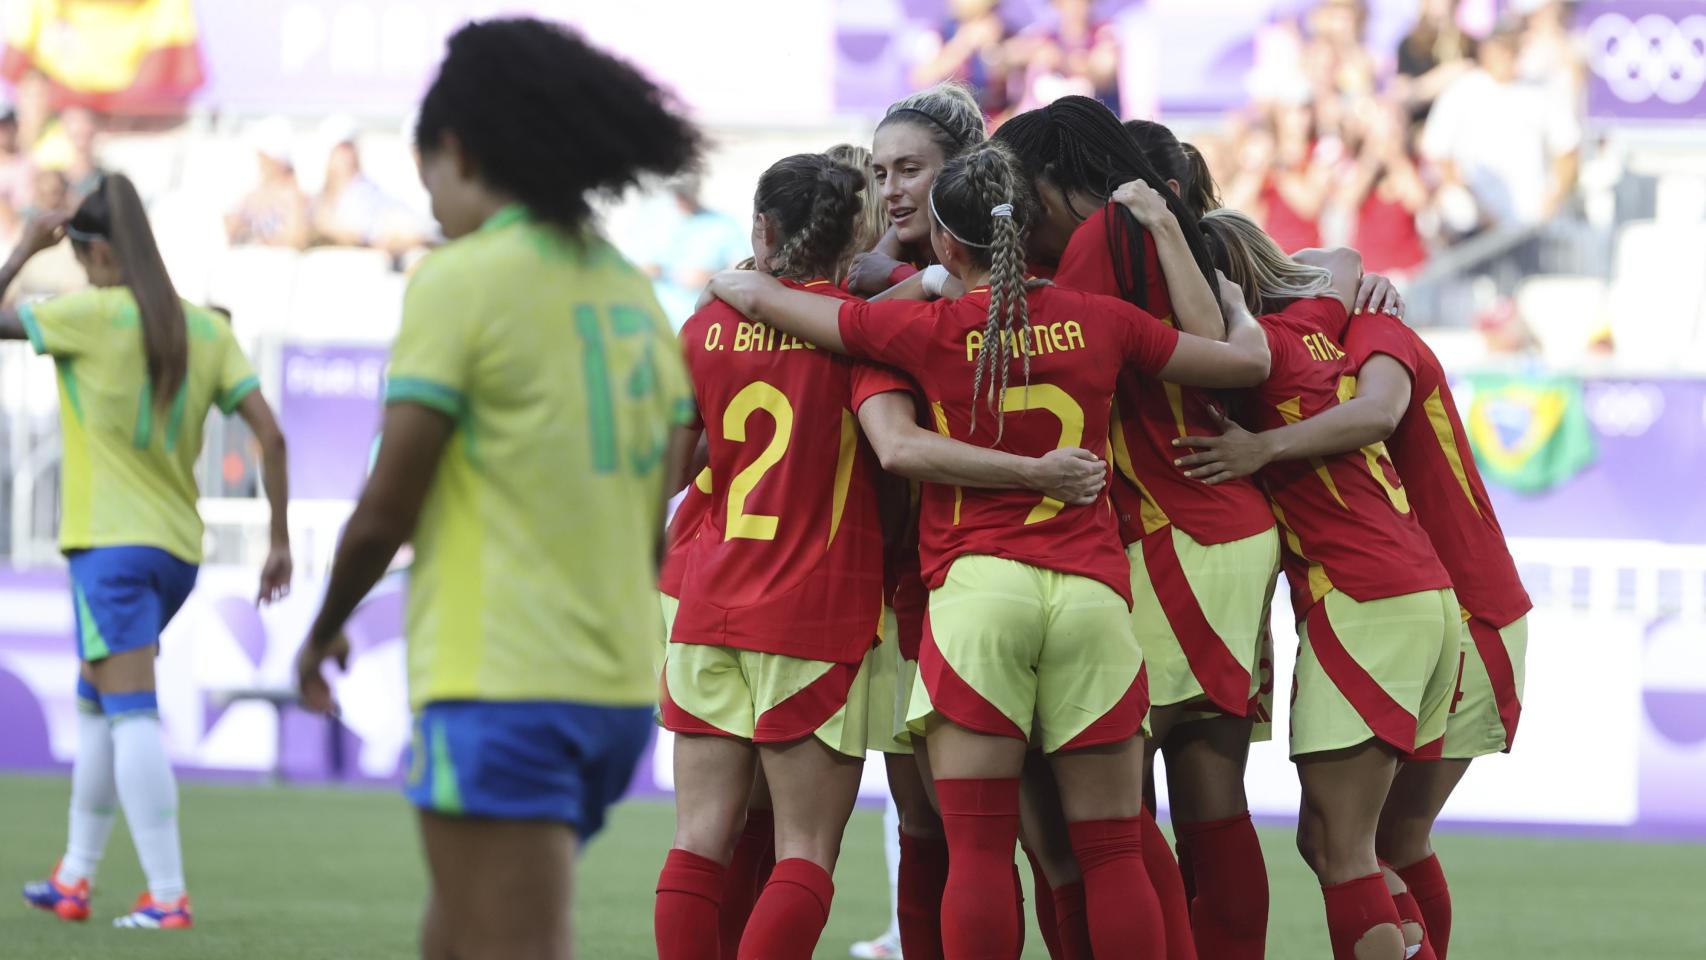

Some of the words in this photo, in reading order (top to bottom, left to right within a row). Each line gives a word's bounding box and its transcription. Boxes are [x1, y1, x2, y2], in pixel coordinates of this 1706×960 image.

[704, 323, 724, 351] O.
[966, 320, 1085, 361] AHENEA
[723, 381, 793, 542] 2
